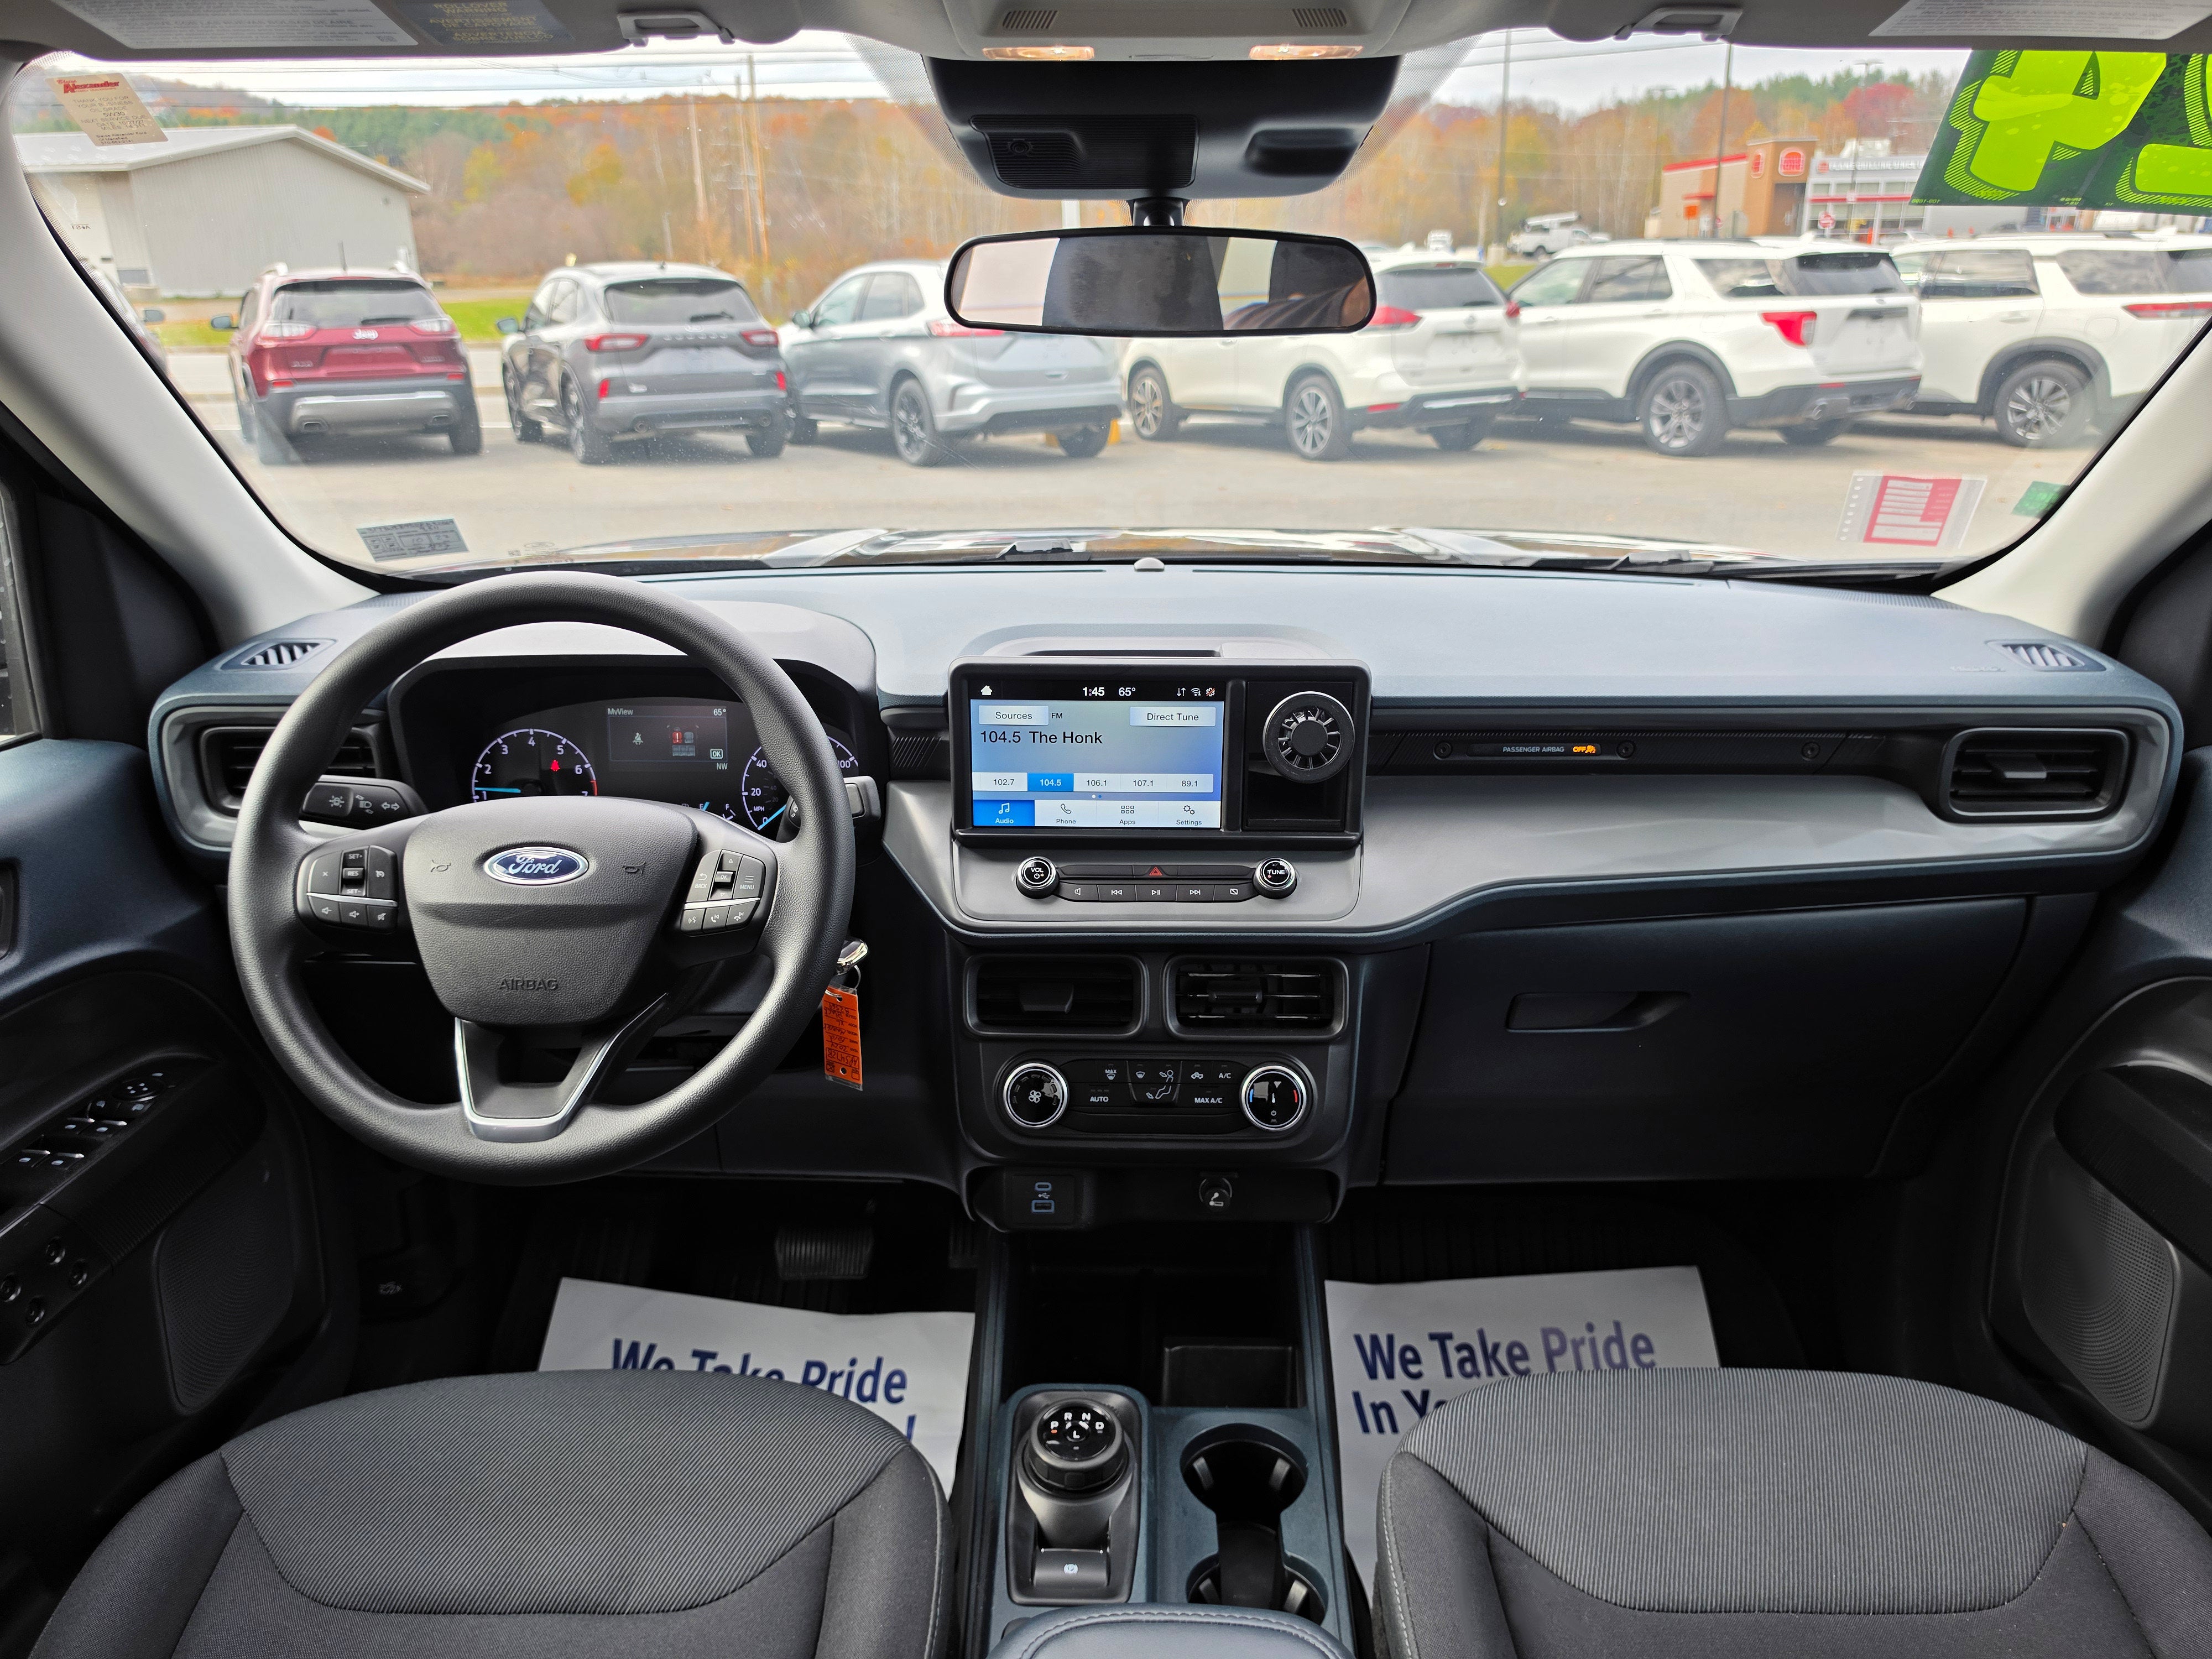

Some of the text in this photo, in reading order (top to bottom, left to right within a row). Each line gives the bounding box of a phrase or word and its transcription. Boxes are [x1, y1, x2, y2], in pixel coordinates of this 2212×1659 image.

[1082, 687, 1136, 696] 1:45 65°
[528, 737, 536, 747] 4
[980, 731, 1103, 744] 104.5 The Honk
[501, 744, 508, 755] 3
[557, 744, 564, 755] 5
[756, 759, 767, 768] 40
[484, 764, 492, 774] 2
[575, 765, 582, 775] 6
[482, 791, 487, 800] 1
[751, 787, 761, 796] 20
[508, 853, 561, 875] Ford
[500, 978, 559, 992] AIRBAG
[1353, 1319, 1656, 1380] We Take Pride
[801, 1357, 908, 1405] Pride
[1064, 1412, 1072, 1421] R
[1082, 1412, 1091, 1421] N
[1352, 1389, 1399, 1435] In
[1050, 1421, 1059, 1430] P
[1095, 1421, 1104, 1430] D
[1073, 1430, 1080, 1439] L
